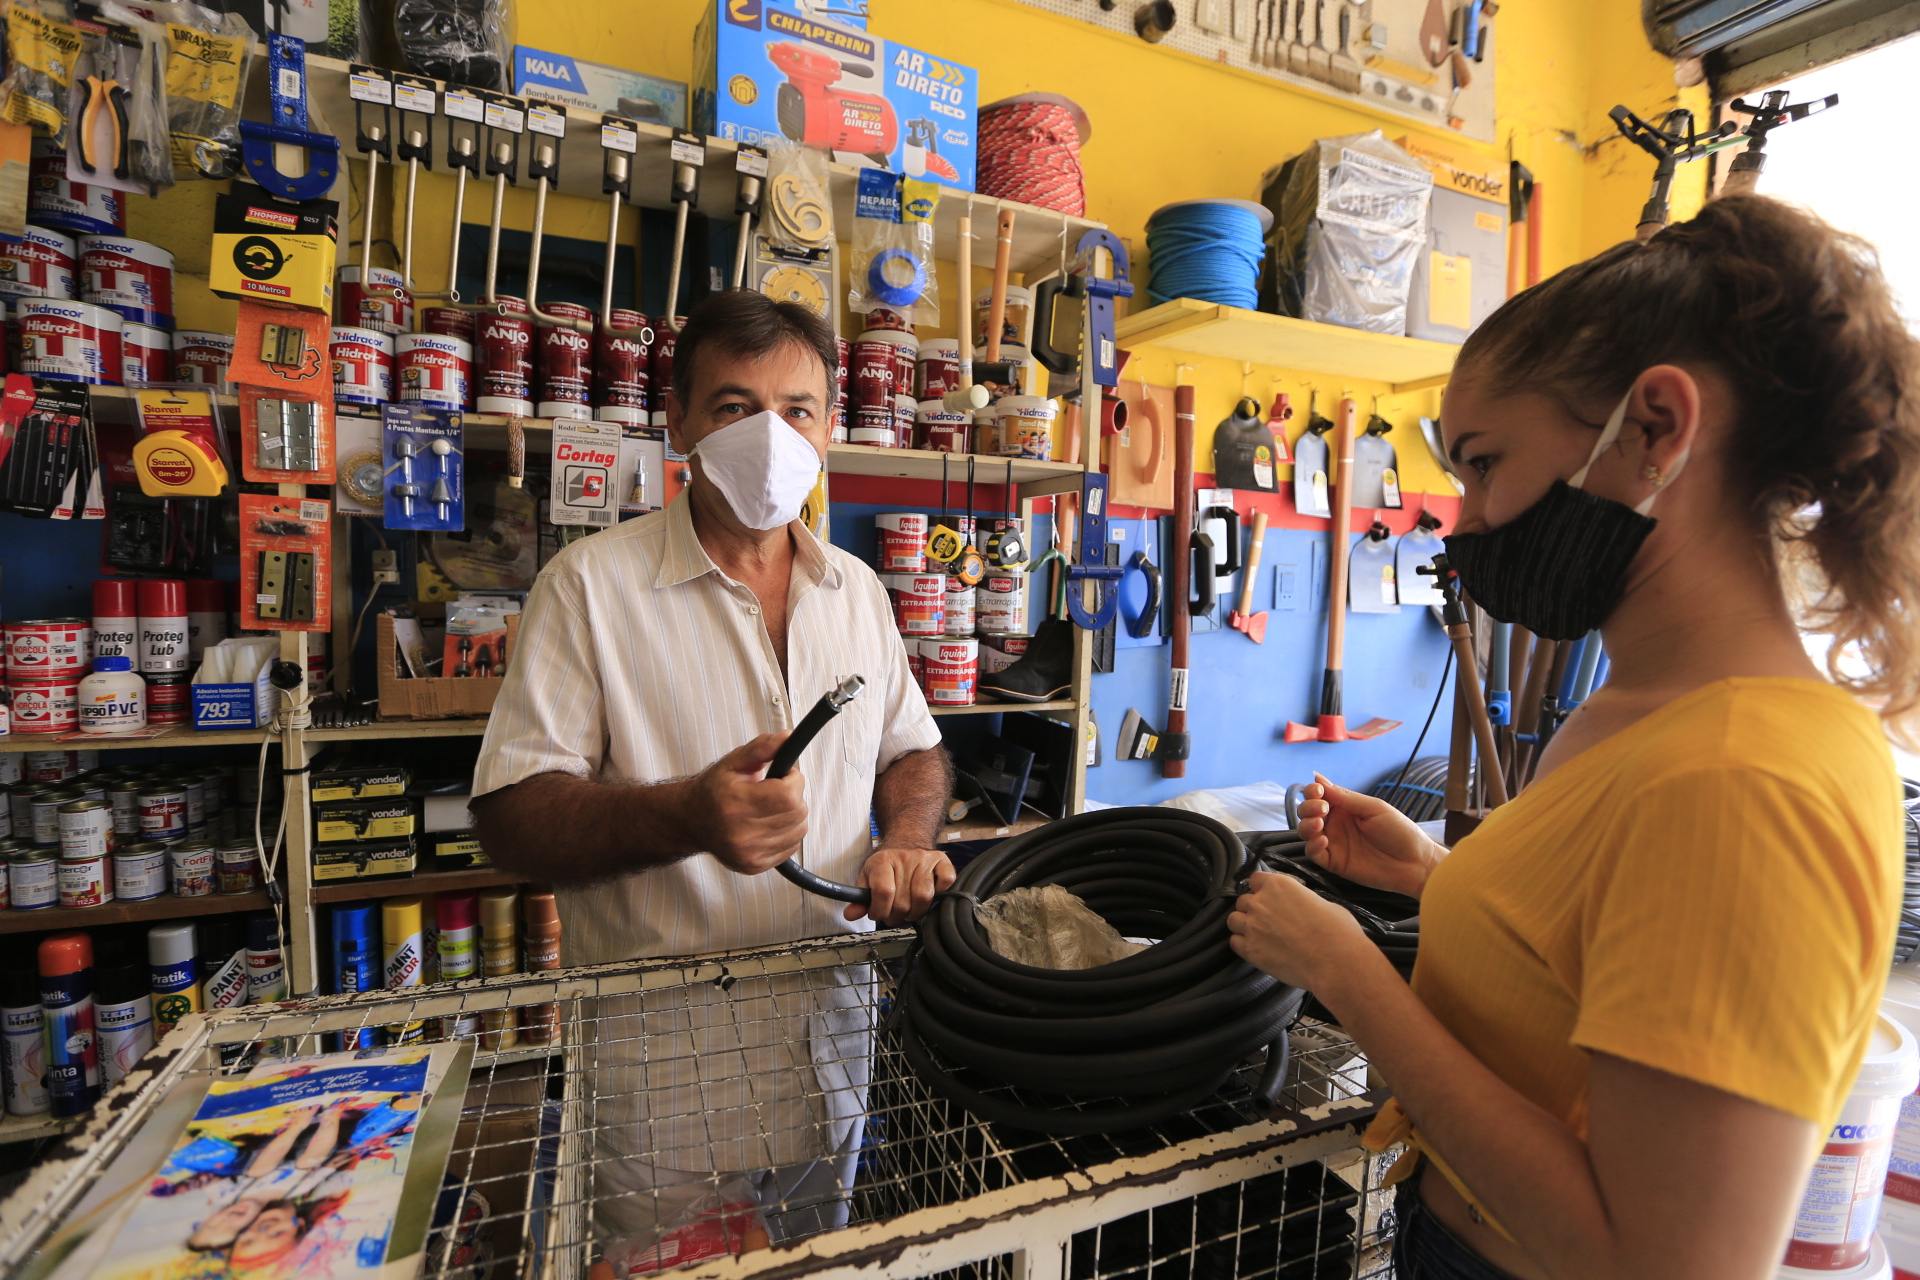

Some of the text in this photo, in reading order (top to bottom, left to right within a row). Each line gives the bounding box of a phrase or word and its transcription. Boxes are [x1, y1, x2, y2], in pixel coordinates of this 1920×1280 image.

[770, 13, 871, 55] CHIAPERINI
[893, 48, 925, 73] AR
[525, 57, 571, 82] KALA
[895, 70, 963, 106] DIRETO
[525, 87, 597, 109] Bomba Periférica
[842, 108, 860, 119] AR
[930, 100, 967, 120] RED
[844, 118, 882, 130] DIRETO
[1451, 168, 1503, 197] vonder
[249, 209, 294, 224] THOMPSON
[303, 216, 319, 224] 0257
[24, 231, 64, 248] dracor
[83, 240, 134, 253] Hidracor
[246, 281, 286, 295] 10 Metros
[24, 303, 84, 318] Hidracor
[495, 320, 519, 329] Thinner
[333, 330, 383, 347] Hidracor
[483, 326, 529, 345] ANJO
[411, 338, 458, 352] Hidracor
[546, 333, 589, 351] ANJO
[609, 338, 648, 357] ANJO
[835, 366, 848, 378] JO
[859, 367, 894, 382] ANJO
[6, 392, 37, 401] WORKER
[144, 404, 182, 414] Starrett
[386, 417, 399, 425] Jogo
[925, 412, 965, 422] Hidracor
[392, 424, 414, 432] Pontas
[415, 426, 445, 435] Montadas
[558, 424, 576, 432] Rodel
[930, 425, 955, 433] Massa
[1018, 419, 1036, 428] Rend
[557, 444, 615, 468] Cortag
[151, 458, 187, 467] Starrett
[901, 520, 922, 531] Iquine
[914, 580, 939, 592] Iquine
[991, 580, 1011, 589] Iquine
[93, 630, 134, 645] Proteg
[143, 630, 184, 644] Proteg
[14, 646, 48, 654] NORCOLA
[100, 644, 123, 656] Lub
[150, 643, 175, 656] Lub
[940, 648, 967, 660] Iquine
[1006, 643, 1027, 653] Iquine
[108, 702, 138, 716] PVC
[198, 701, 231, 719] 793
[366, 774, 399, 785] vonder
[371, 808, 406, 818] vonder
[371, 848, 407, 860] vonder
[440, 944, 456, 952] Tinta
[386, 945, 416, 977] PAINT
[441, 958, 472, 968] LUMINOSA
[530, 952, 559, 962] METÁLICA
[152, 971, 188, 984] Pratik
[388, 956, 420, 989] COLOR
[210, 961, 244, 998] PAINT
[42, 990, 66, 1001] ratik
[213, 972, 248, 1009] COLOR
[100, 1013, 135, 1023] BOND
[272, 1090, 303, 1099] Cores
